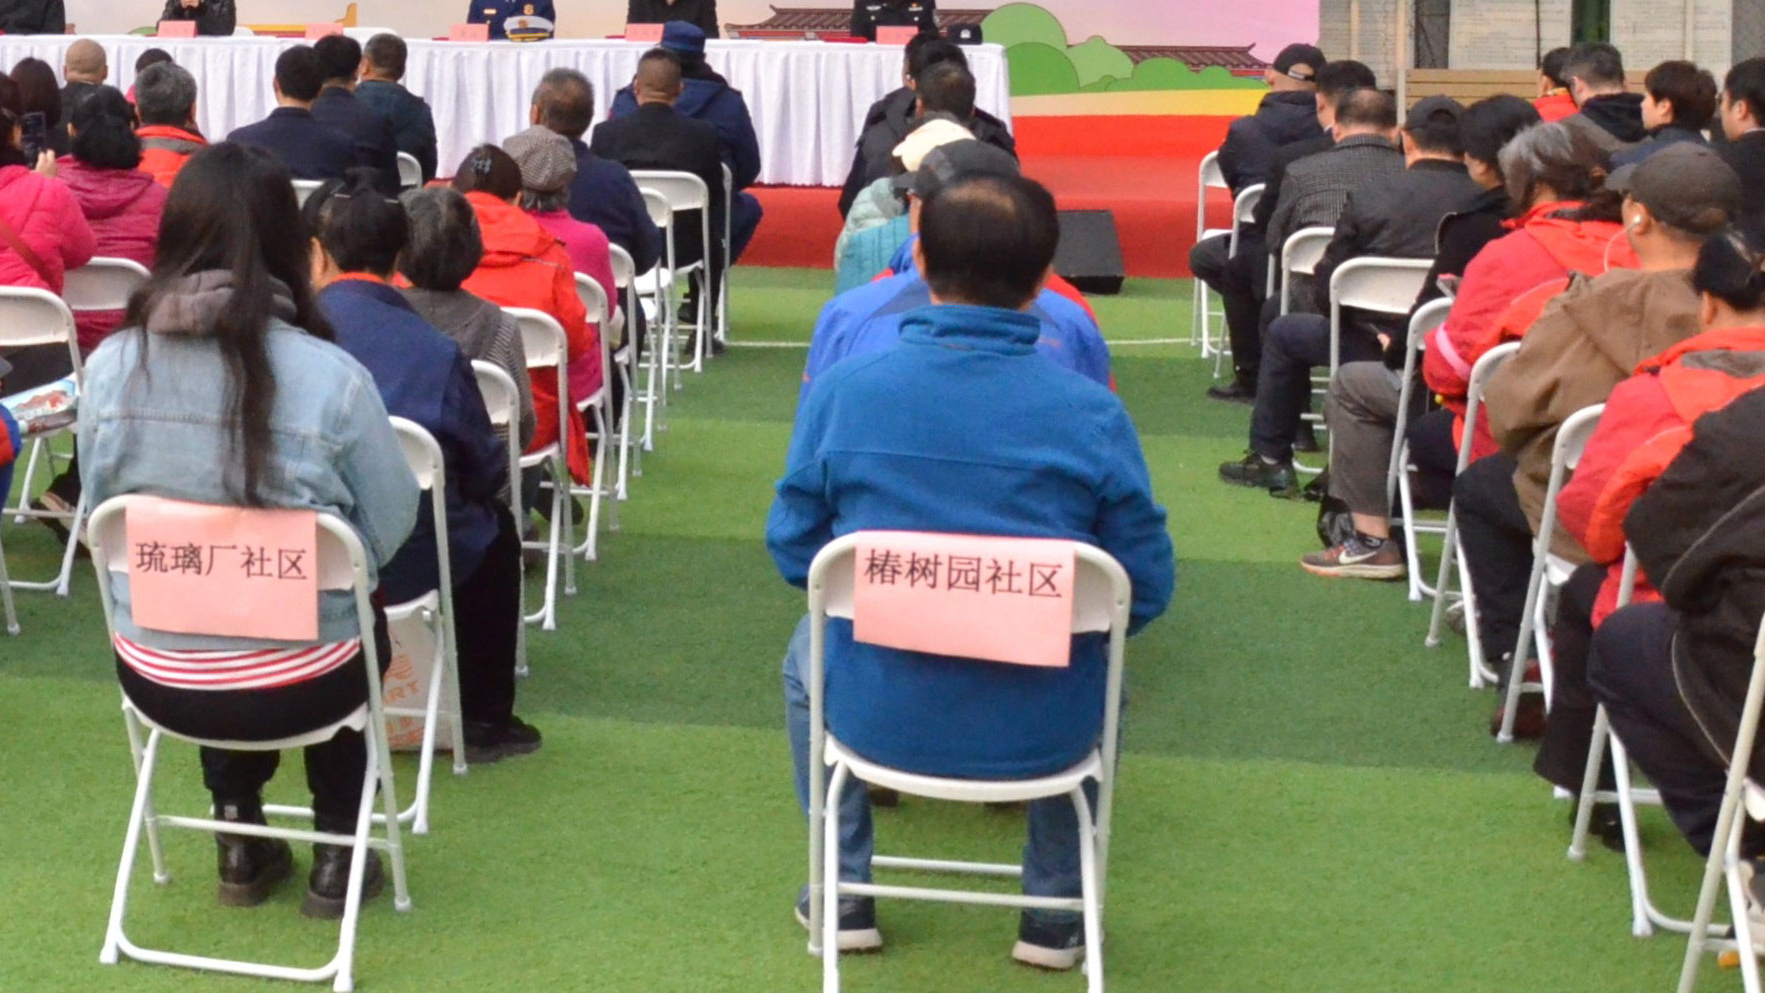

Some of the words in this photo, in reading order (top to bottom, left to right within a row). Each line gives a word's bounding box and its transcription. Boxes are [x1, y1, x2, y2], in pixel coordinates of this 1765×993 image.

[135, 542, 308, 581] 琉璃厂社区
[865, 548, 1064, 598] 椿树园社区
